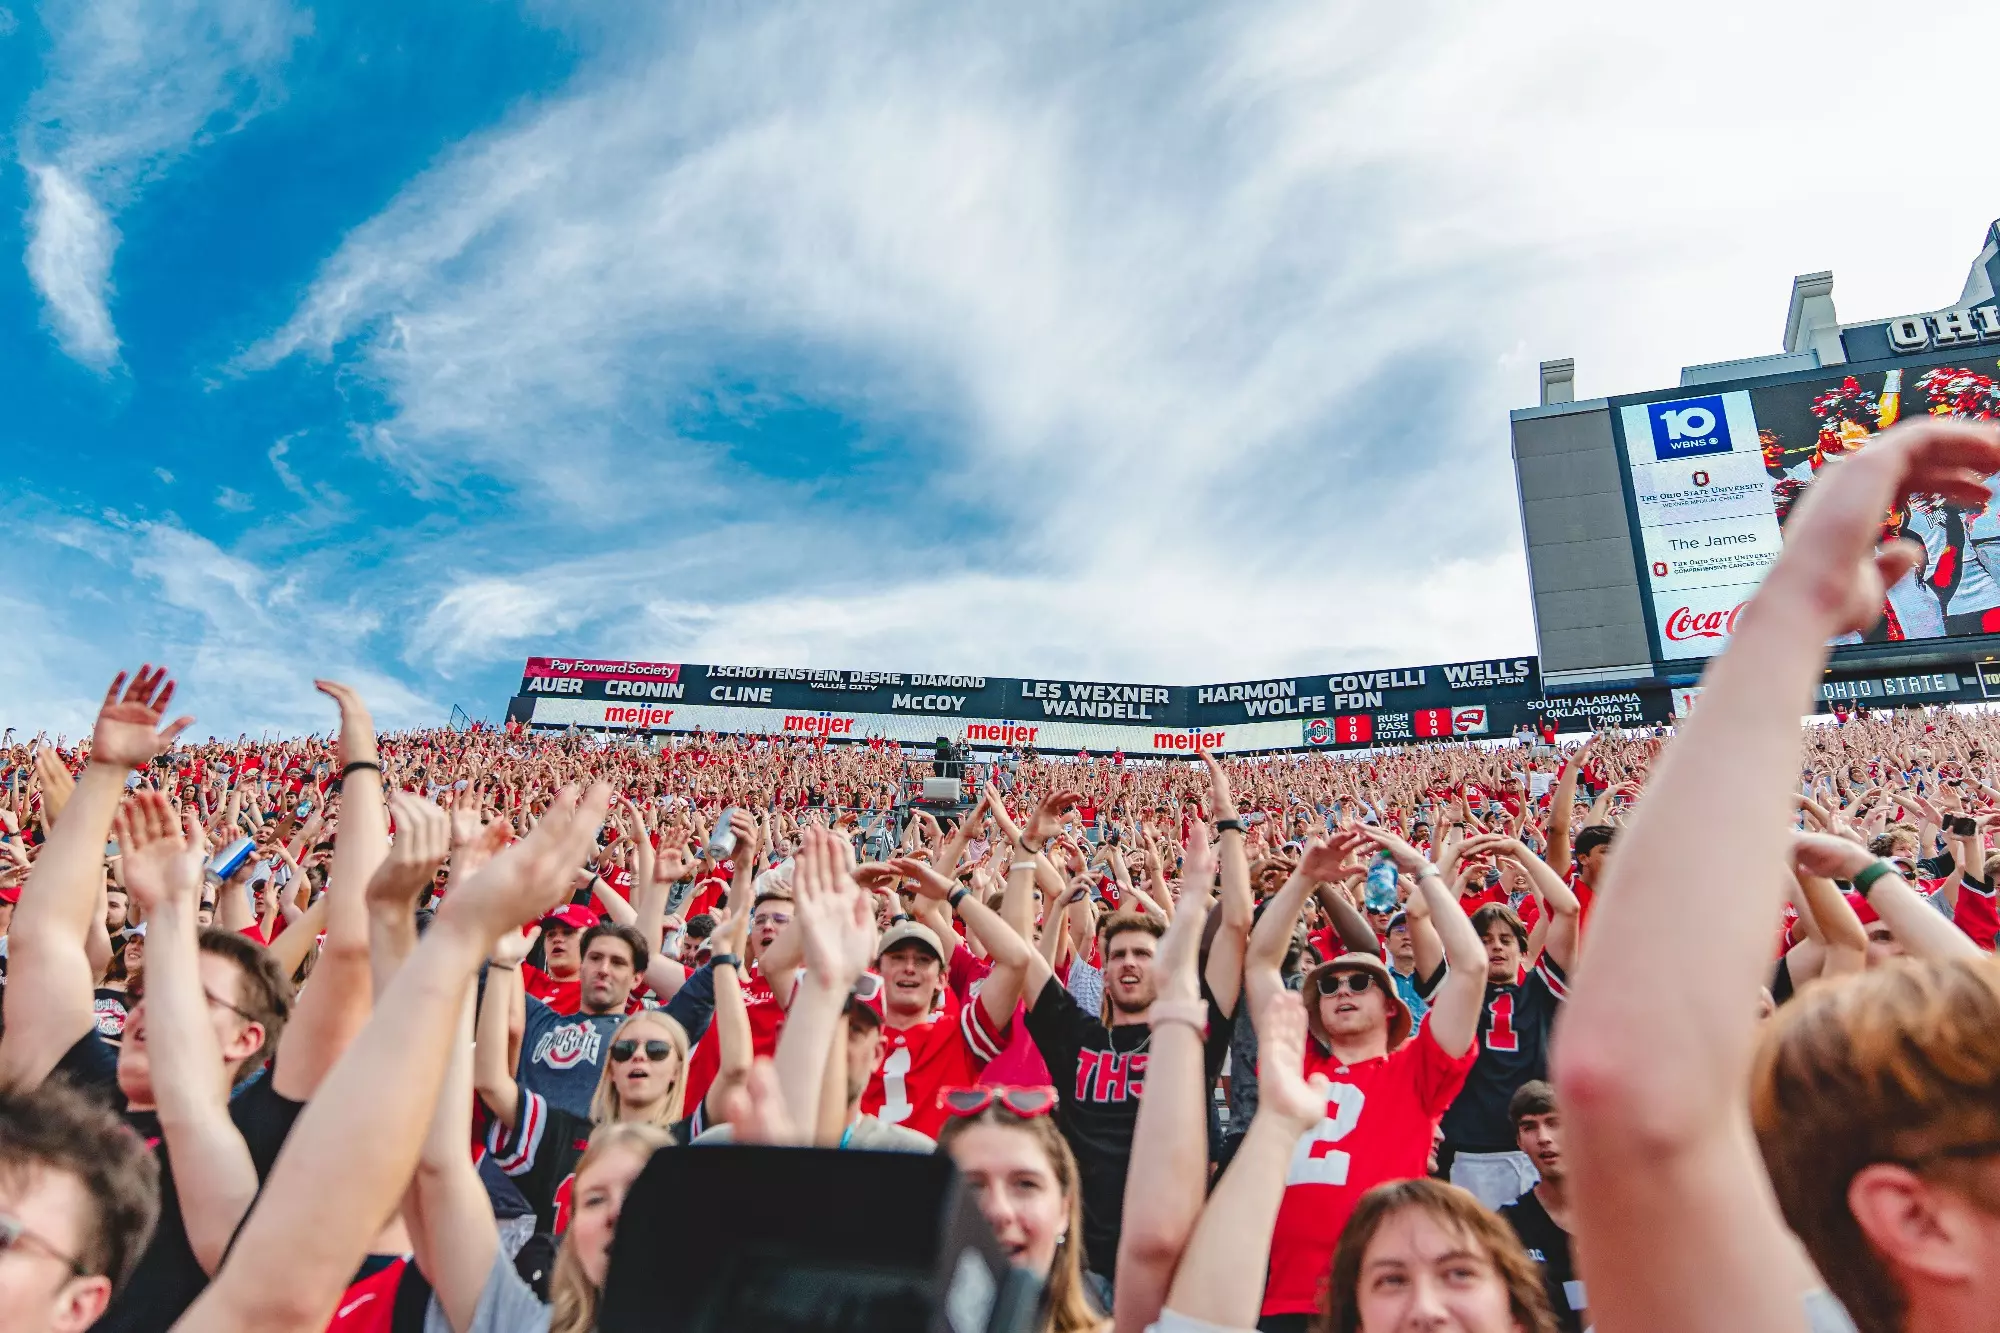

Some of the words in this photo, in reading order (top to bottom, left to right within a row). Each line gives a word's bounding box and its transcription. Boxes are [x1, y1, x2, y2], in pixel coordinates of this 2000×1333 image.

[1660, 407, 1716, 440] 10
[1671, 439, 1707, 450] WBNS
[1668, 538, 1700, 551] The
[1705, 532, 1757, 547] James
[551, 659, 571, 674] Pay
[574, 661, 627, 674] Forward
[627, 663, 675, 679] Society
[1443, 660, 1530, 683] WELLS
[527, 677, 584, 694] AUER
[604, 680, 684, 699] CRONIN
[810, 682, 847, 690] VALUE
[849, 684, 878, 692] CITY
[911, 674, 986, 689] DIAMOND
[1328, 669, 1426, 693] COVELLI
[1451, 679, 1493, 689] DAVIS
[1497, 676, 1525, 685] FDN
[1823, 681, 1871, 699] OHIO
[1883, 674, 1947, 695] STATE
[710, 685, 773, 703] CLINE
[892, 693, 966, 711] McCOY
[1021, 682, 1062, 700] LES
[1069, 684, 1170, 704] WEXNER
[1198, 680, 1296, 704] HARMON
[1527, 698, 1572, 710] SOUTH
[1575, 692, 1641, 706] ALABAMA
[604, 702, 674, 727] meijer
[1042, 700, 1153, 720] WANDELL
[1244, 695, 1326, 717] WOLFE
[1334, 691, 1383, 710] FDN
[1546, 705, 1622, 718] OKLAHOMA
[1624, 703, 1641, 712] ST
[784, 711, 854, 736] meijer
[1350, 716, 1357, 725] 0
[1377, 712, 1409, 722] RUSH
[1429, 711, 1437, 719] 0
[1350, 725, 1357, 733] 0
[1378, 721, 1409, 731] PASS
[1430, 719, 1438, 727] 0
[1597, 715, 1622, 724] 7:00
[1625, 712, 1643, 721] PM
[967, 720, 1038, 745] meijer
[1153, 728, 1225, 753] meijer
[1350, 734, 1358, 742] 0
[1375, 730, 1413, 740] TOTAL
[1431, 727, 1439, 736] 0
[1486, 992, 1519, 1052] 1
[878, 1047, 913, 1123] 1
[1287, 1083, 1365, 1186] 2
